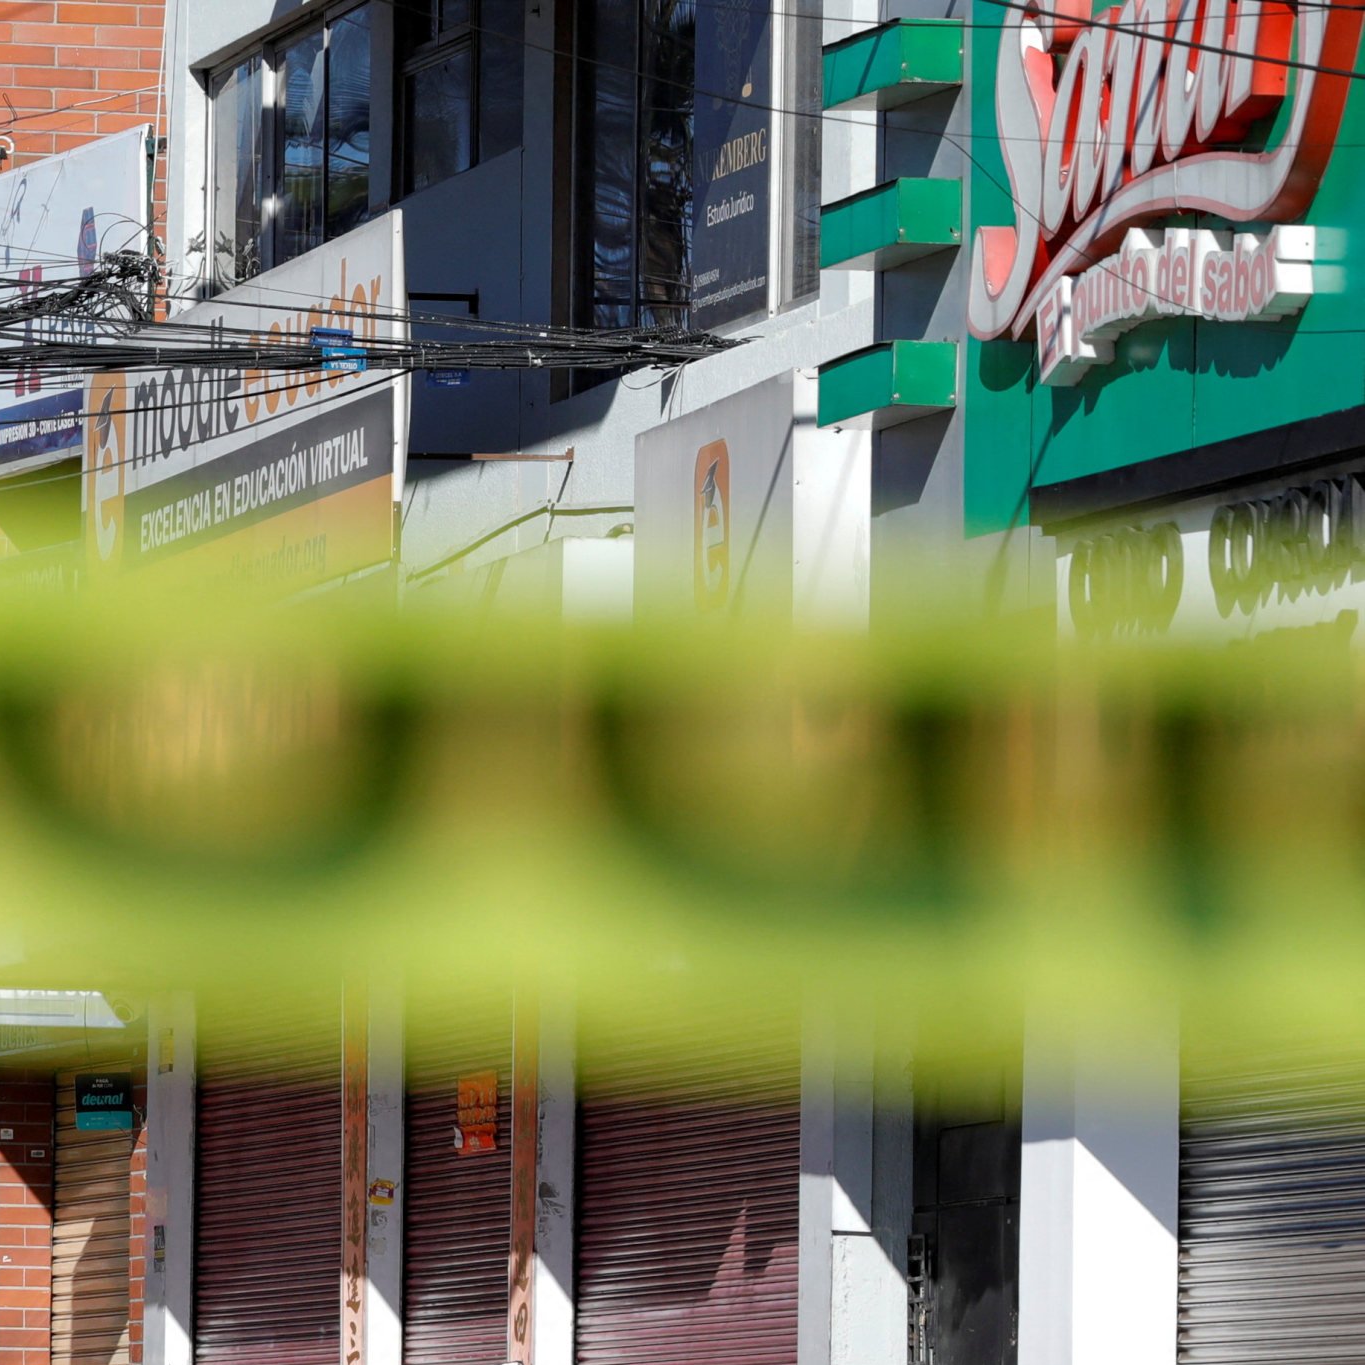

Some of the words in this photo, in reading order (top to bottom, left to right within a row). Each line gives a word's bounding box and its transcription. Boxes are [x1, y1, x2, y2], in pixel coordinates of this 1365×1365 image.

[698, 128, 767, 186] NUREMBERG
[707, 202, 729, 227] Estudio
[729, 191, 754, 222] Jurídico
[1038, 290, 1071, 370] El
[1071, 250, 1149, 337] punto
[1156, 238, 1195, 306] del
[1201, 238, 1277, 320] sabor
[140, 494, 212, 553] EXCELENCIA
[215, 486, 231, 523] EN
[233, 441, 307, 515] EDUCACIÓN
[311, 427, 369, 486] VIRTUAL
[82, 1092, 124, 1107] deuna!
